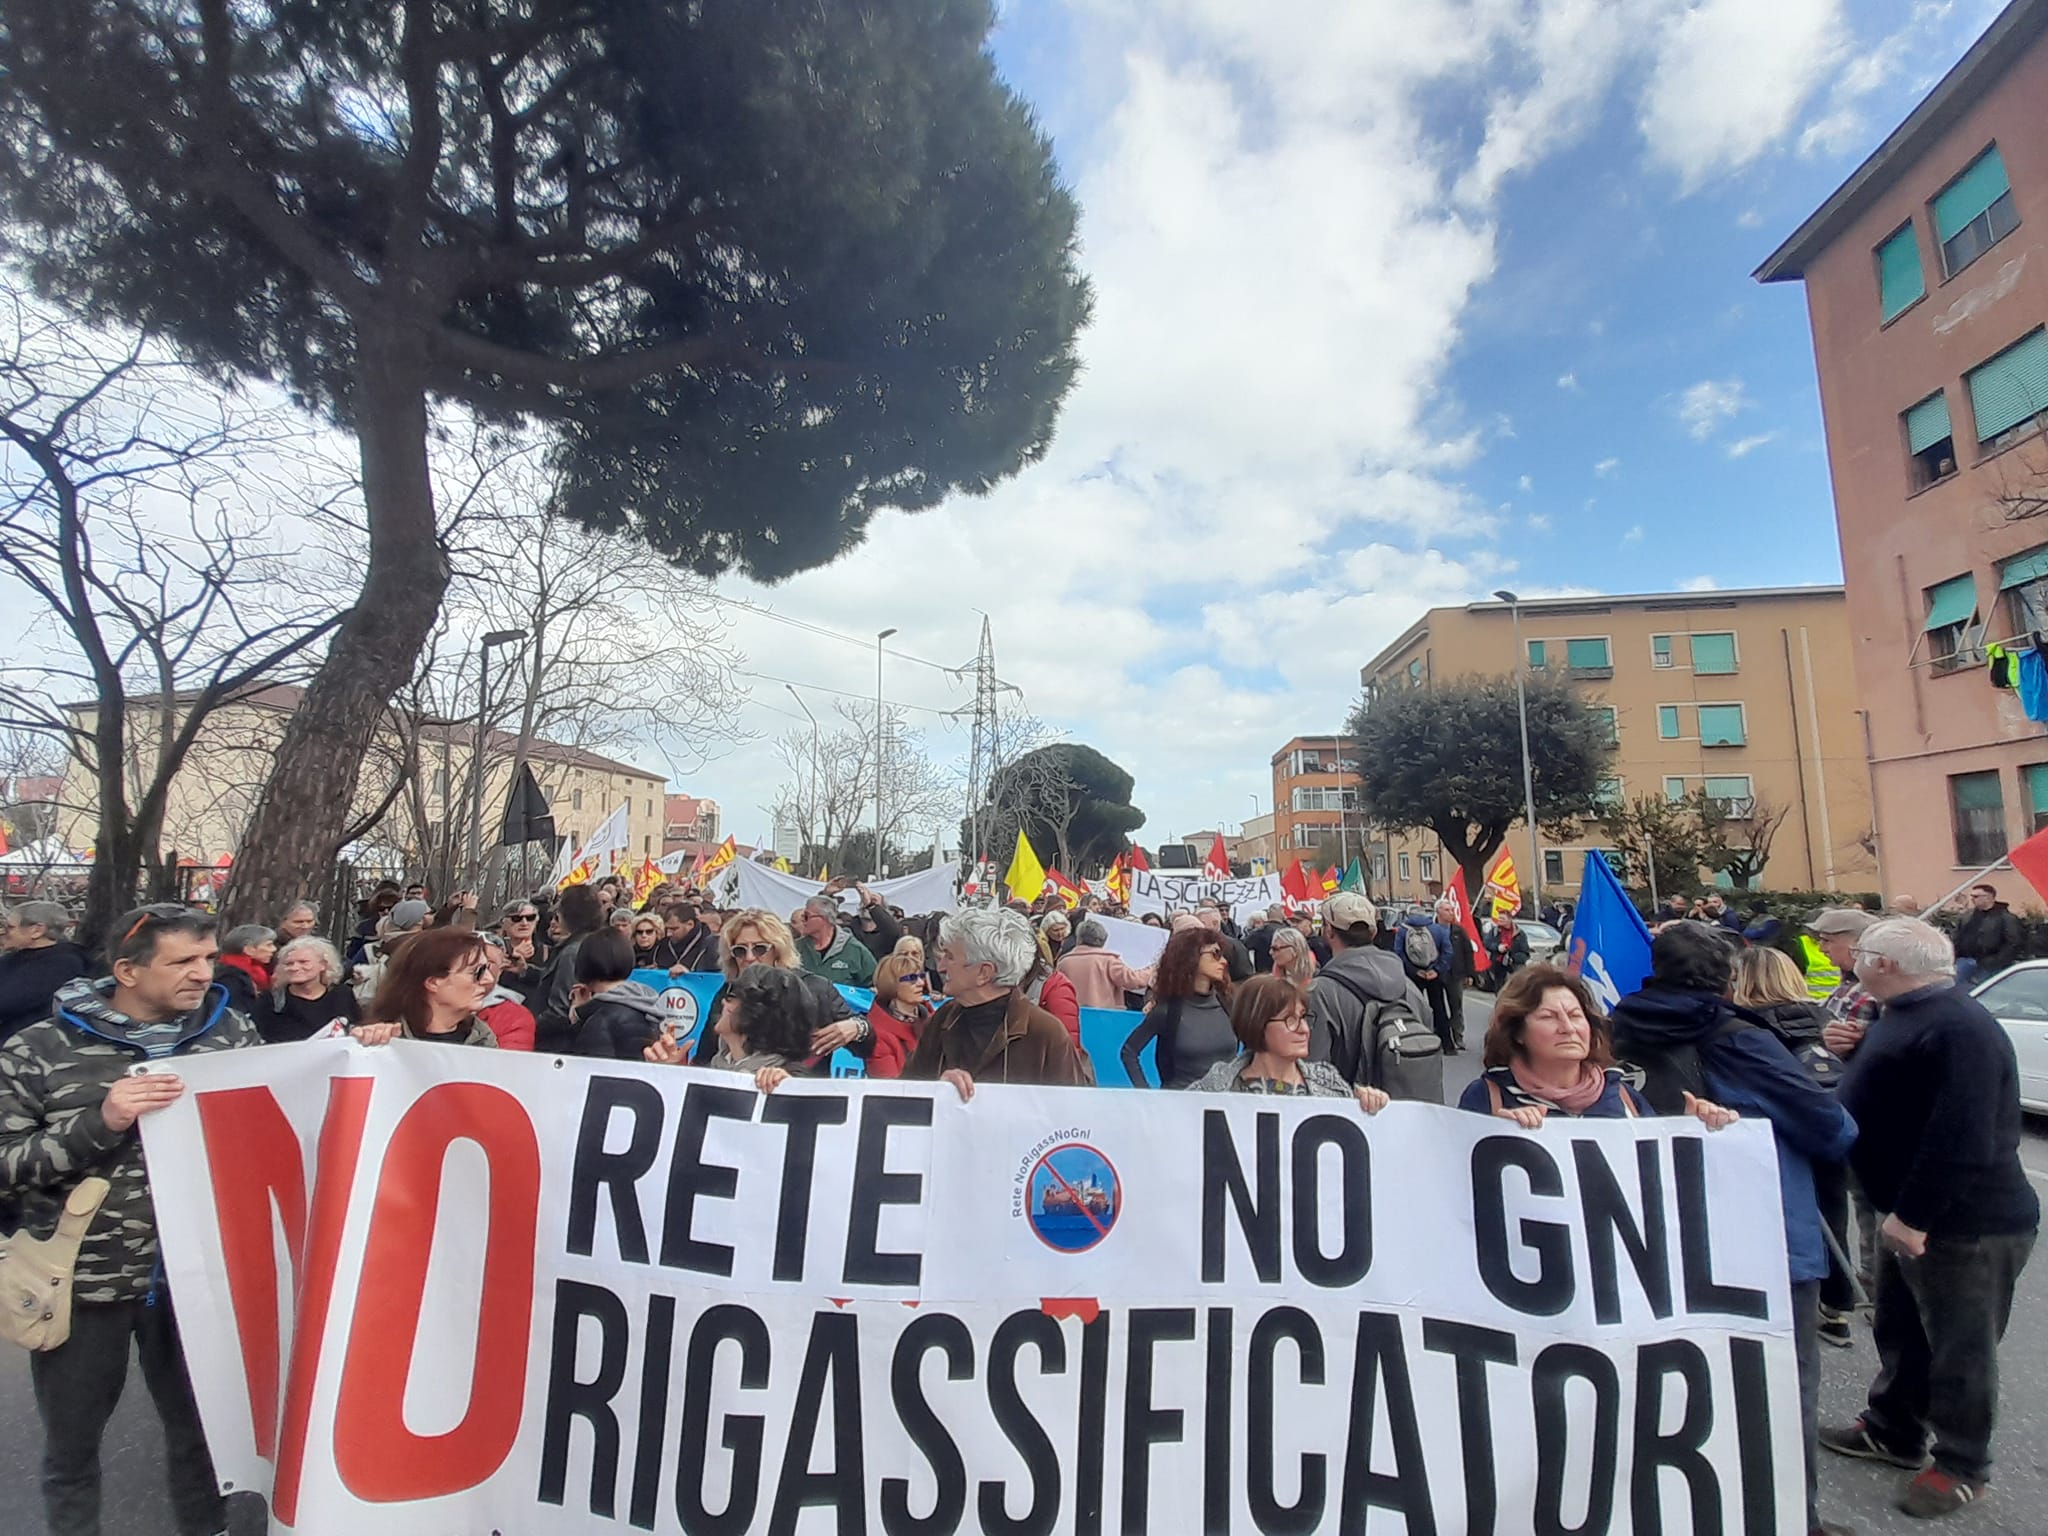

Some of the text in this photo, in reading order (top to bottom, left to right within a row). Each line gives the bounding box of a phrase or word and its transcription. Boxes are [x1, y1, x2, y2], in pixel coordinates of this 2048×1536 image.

[666, 997, 686, 1009] NO
[195, 1075, 541, 1527] NO
[566, 1075, 1769, 1325] RETE NO GNL
[1012, 1187, 1022, 1218] Rete
[537, 1279, 1777, 1536] RIGASSIFICATORI
